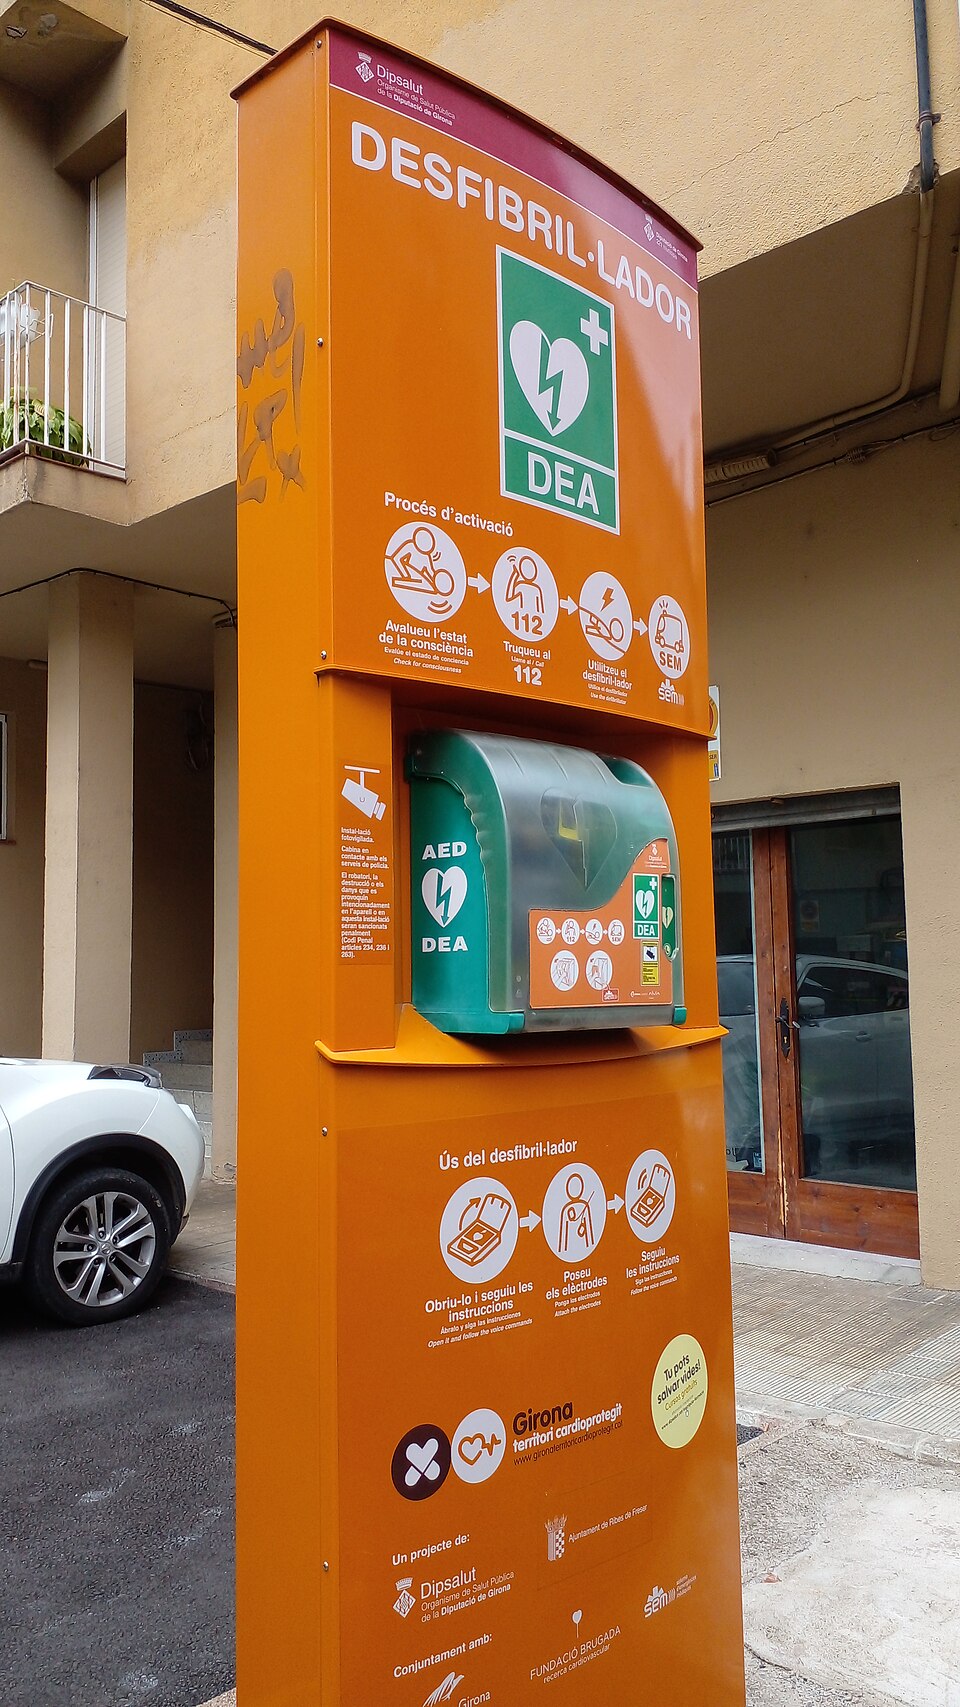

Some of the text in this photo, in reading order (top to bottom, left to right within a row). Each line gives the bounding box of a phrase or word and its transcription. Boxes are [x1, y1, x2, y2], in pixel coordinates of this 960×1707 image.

[377, 64, 423, 95] Dipsalut
[528, 452, 600, 515] DEA
[384, 492, 437, 517] Procés
[386, 620, 430, 637] Avalueu
[511, 611, 543, 635] 112
[379, 632, 473, 657] de la consciència
[503, 640, 550, 660] Truqueu al
[394, 658, 411, 666] Check
[422, 663, 462, 673] consciousness
[412, 651, 431, 659] estado
[441, 656, 469, 665] conciencia
[588, 659, 627, 678] Utilitzeu el
[660, 651, 681, 672] SEM
[514, 664, 542, 686] 112
[422, 842, 467, 860] AED
[638, 925, 655, 936] DEA
[422, 936, 468, 952] DEA
[440, 1150, 459, 1170] Ús
[464, 1149, 485, 1167] del
[625, 1254, 679, 1278] les instruccions
[641, 1246, 666, 1262] Seguiu
[564, 1268, 591, 1283] Poseu
[426, 1282, 533, 1313] Obriu-lo i seguiu les
[546, 1276, 607, 1300] els elèctrodes
[449, 1300, 514, 1322] instruccions
[555, 1299, 569, 1308] Ponga
[555, 1309, 570, 1317] Attach
[428, 1340, 444, 1348] Open
[451, 1335, 461, 1343] and
[463, 1332, 479, 1340] follow
[490, 1325, 504, 1333] voice
[505, 1318, 532, 1330] commands
[460, 1324, 464, 1332] y
[465, 1321, 476, 1330] siga
[487, 1311, 521, 1324] instrucciones
[664, 1355, 690, 1381] Tu pots
[657, 1359, 701, 1405] salvar vides!
[665, 1393, 681, 1411] Cursos
[513, 1402, 573, 1435] Girona
[513, 1403, 622, 1453] territori cardioprotegit
[569, 1504, 647, 1543] Ajuntament de Ribes de Freser
[392, 1534, 470, 1566] Un projecte de:
[421, 1567, 476, 1599] Dipsalut
[421, 1571, 514, 1611] Organisme de Salut Pública
[422, 1583, 510, 1622] de la Diputació de Girona
[394, 1633, 492, 1678] Conjuntament amb:
[530, 1626, 620, 1680] FUNDACIÓ BRUGADA
[543, 1643, 610, 1684] recerca cardiovascular
[458, 1691, 491, 1707] Girona
